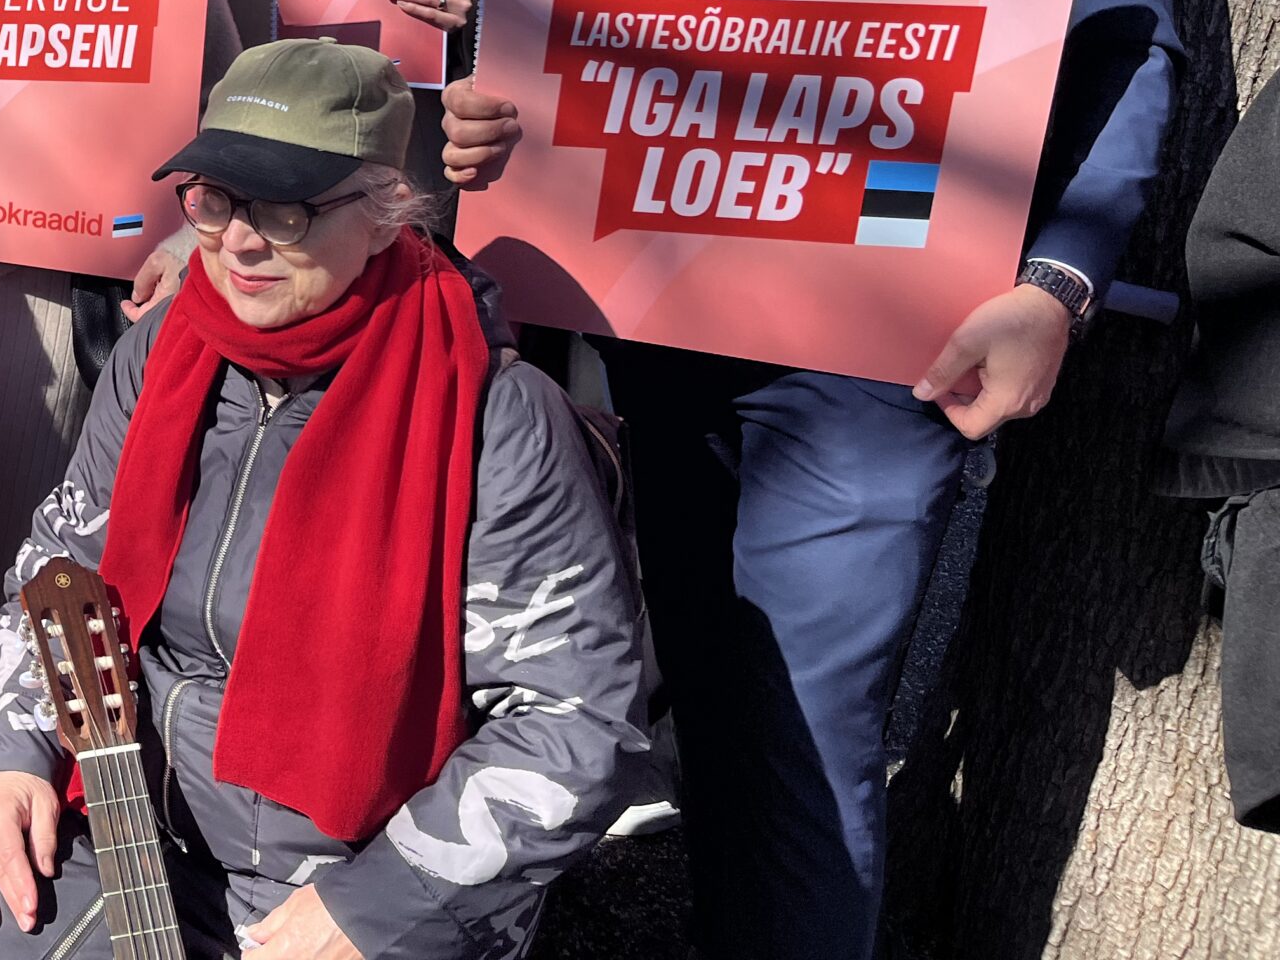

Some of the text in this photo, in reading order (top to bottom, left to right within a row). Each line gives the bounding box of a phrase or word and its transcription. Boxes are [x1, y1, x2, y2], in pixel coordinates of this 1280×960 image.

[570, 7, 961, 62] LASTESÕBRALIK EESTI
[226, 95, 289, 112] COPENHAGEN
[732, 70, 925, 152] LAPS
